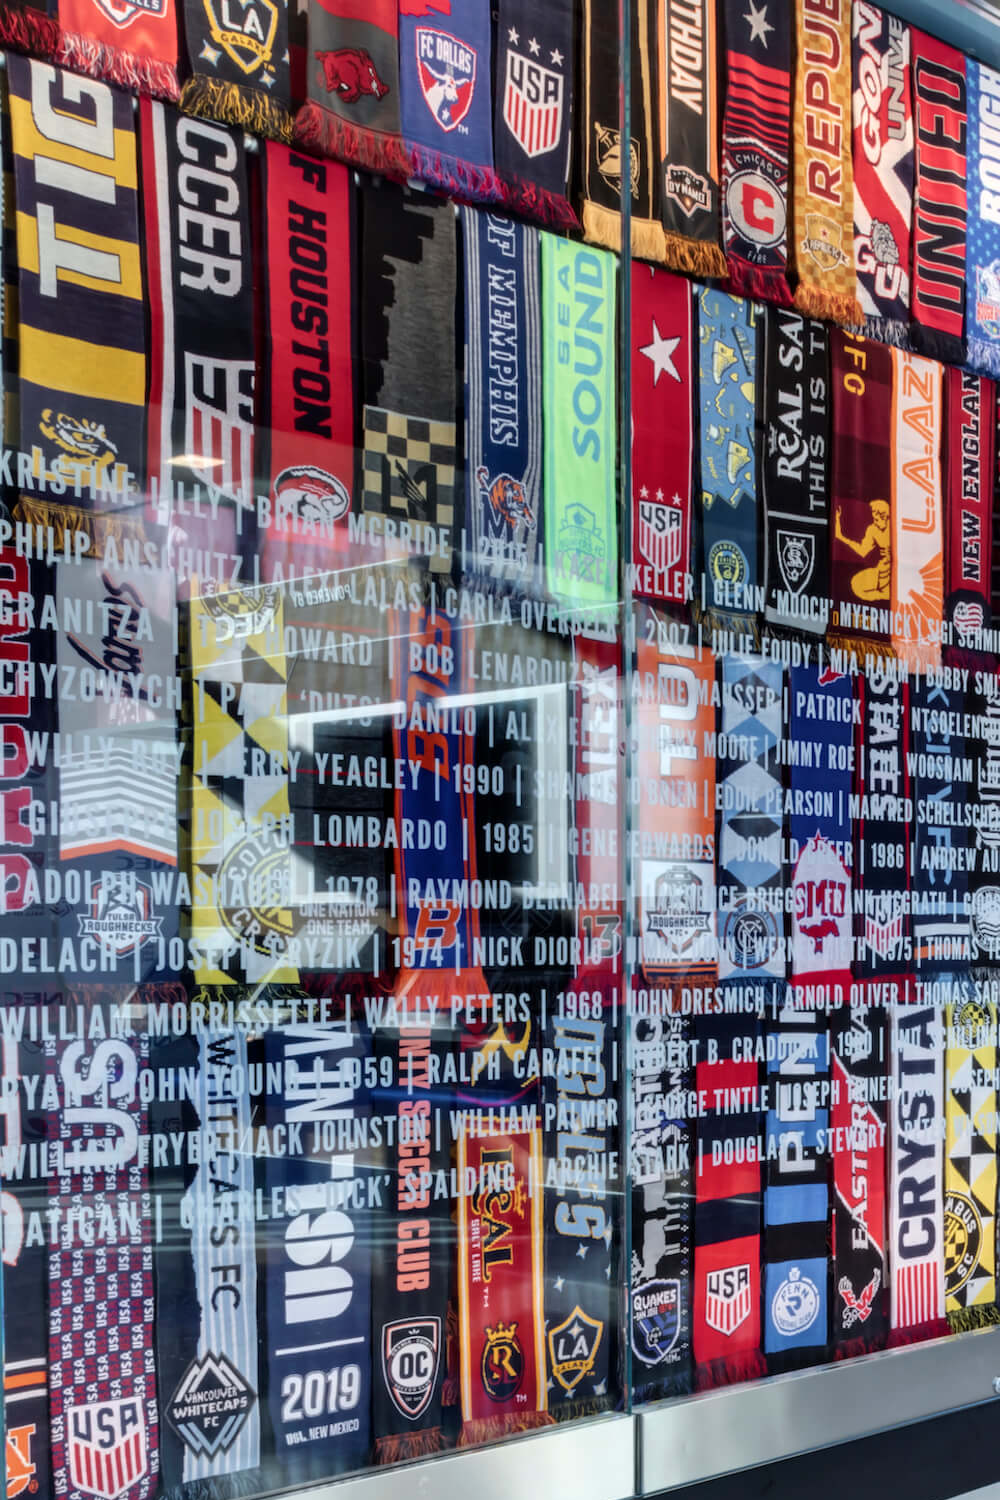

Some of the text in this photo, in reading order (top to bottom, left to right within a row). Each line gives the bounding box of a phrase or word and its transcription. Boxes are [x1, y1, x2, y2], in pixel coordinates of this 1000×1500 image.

[222, 7, 265, 41] LA
[420, 33, 473, 73] FC DALLAS
[510, 54, 560, 106] USA
[735, 152, 782, 180] CHICAGO
[287, 200, 333, 441] HOUSTON
[488, 263, 520, 448] MEMPHIS
[809, 377, 826, 512] THIS IS
[640, 501, 681, 533] USA
[0, 449, 136, 506] KRISTINE
[151, 476, 221, 521] LILLY
[257, 495, 334, 540] BRIAN
[349, 512, 450, 560] MCBRIDE
[713, 577, 765, 615] GLENN
[839, 600, 912, 644] MYERNICK
[962, 509, 981, 583] NEW
[0, 519, 91, 567] PHILIP
[351, 573, 421, 615] LALAS
[711, 627, 754, 658] JULIE
[762, 638, 811, 671] FOUDY
[865, 653, 909, 684] HAMM
[926, 664, 969, 694] BOBBY
[410, 641, 862, 726] BOB PATRICK
[393, 701, 477, 737] DANILO
[704, 730, 758, 763] MOORE
[775, 738, 823, 771] JIMMY
[828, 743, 856, 773] ROE
[906, 751, 973, 783] WOOSNAM
[314, 751, 422, 791] YEAGLEY
[452, 765, 504, 797] 1990
[765, 786, 834, 819] PEARSON
[313, 813, 448, 852] LOMBARDO
[483, 822, 534, 855] 1985
[871, 843, 904, 869] 1986
[921, 845, 976, 873] ANDREW
[23, 868, 512, 911] ADOLPH 1978 RAYMOND
[87, 921, 154, 935] ROUGHNECKS
[108, 911, 135, 923] TULSA
[651, 915, 706, 929] ROUGHNECKS
[0, 935, 979, 974] DELACH JOSEPH 1974 NICK DIORIO THOMAS
[0, 1002, 134, 1043] WILLIAM
[150, 997, 333, 1039] MORRISSETTE
[364, 995, 441, 1029] WALLY
[451, 992, 531, 1026] PETERS
[556, 991, 602, 1020] 1968
[681, 984, 765, 1016] DRESMICH
[785, 983, 843, 1013] ARNOLD
[851, 982, 899, 1008] OLIVER
[914, 981, 969, 1007] THOMAS
[428, 1053, 501, 1086] RALPH
[313, 1113, 426, 1153] JOHNSTON
[451, 1103, 538, 1140] WILLIAM
[545, 1097, 618, 1131] PALMER
[714, 1086, 770, 1111] TINTLE
[397, 1100, 431, 1212] SOCCER
[405, 1161, 515, 1204] SPALDING
[547, 1150, 618, 1185] ARCHIE
[396, 1218, 431, 1294] CLUB
[471, 1218, 480, 1284] SALT LAKE
[211, 1264, 241, 1313] FC
[633, 1287, 677, 1307] QUAKES
[707, 1268, 750, 1298] USA
[400, 1349, 429, 1380] OC
[558, 1336, 588, 1361] LA
[172, 1396, 248, 1419] WHITECAPS
[185, 1385, 239, 1404] VANCOUVER
[282, 1363, 361, 1424] 2019
[72, 1405, 139, 1449] USA
[203, 1416, 219, 1429] FC
[309, 1418, 360, 1444] NEW MEXICO
